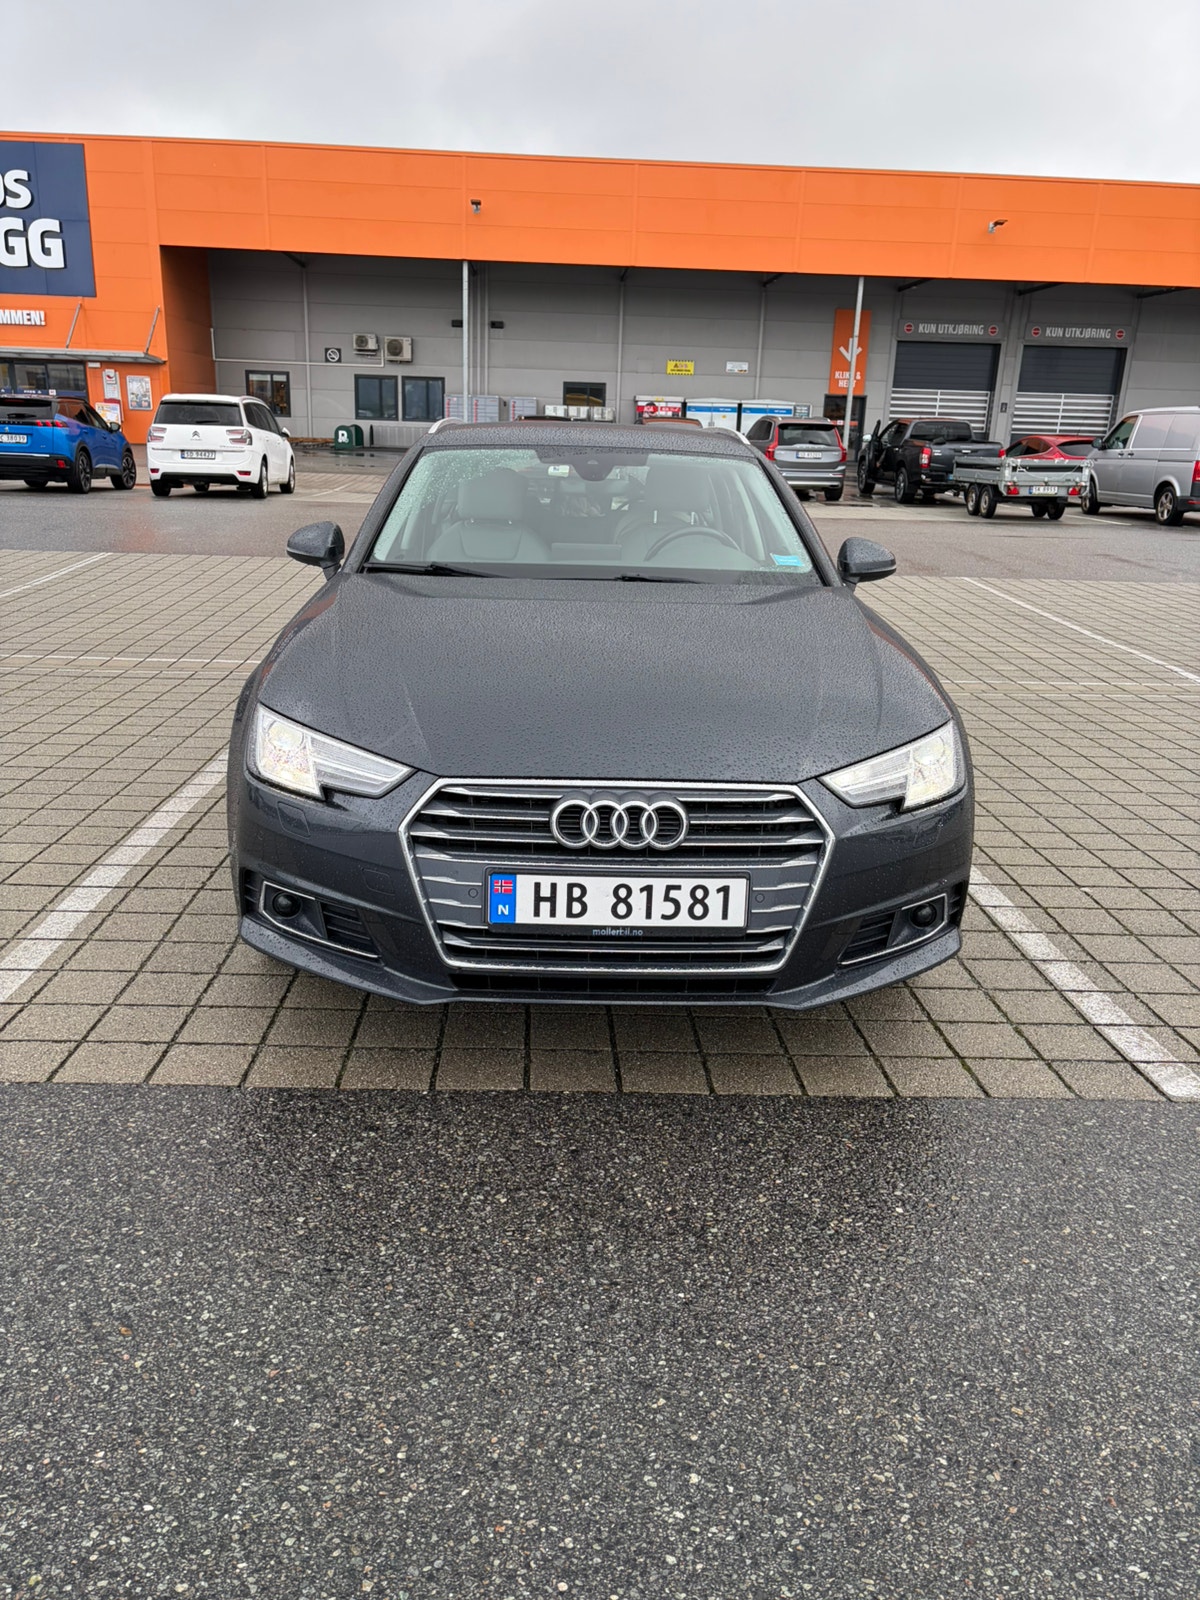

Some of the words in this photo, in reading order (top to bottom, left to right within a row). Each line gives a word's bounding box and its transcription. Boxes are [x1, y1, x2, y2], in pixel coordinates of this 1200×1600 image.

[0, 169, 32, 209] S
[918, 323, 937, 334] KUN
[938, 323, 985, 336] UTKJØRING
[1045, 327, 1064, 338] KUN
[1065, 327, 1112, 339] UTKJØRING
[497, 904, 508, 915] N
[532, 881, 588, 919] HB
[610, 882, 731, 921] 81581
